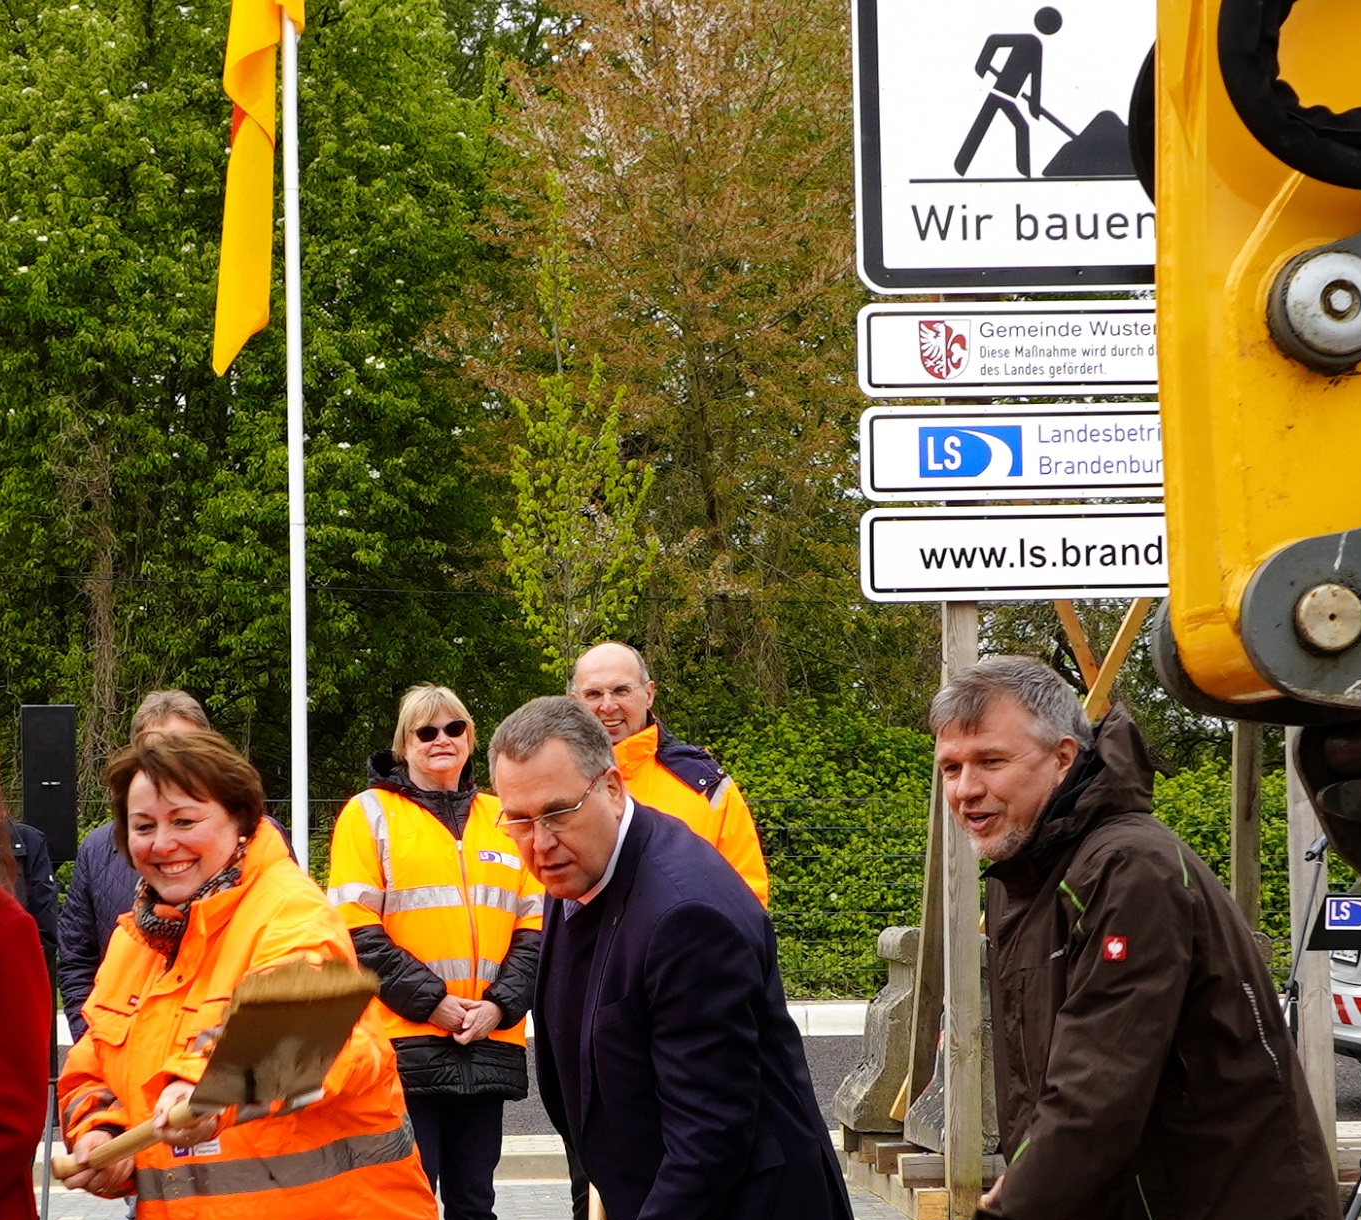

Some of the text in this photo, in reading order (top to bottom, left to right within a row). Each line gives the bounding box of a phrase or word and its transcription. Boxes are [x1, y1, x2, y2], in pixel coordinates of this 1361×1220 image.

[911, 203, 1156, 241] Wir bauen
[980, 321, 1082, 338] Gemeinde
[979, 345, 1010, 358] Diese
[1015, 345, 1077, 358] Maßnahme
[1081, 344, 1106, 357] wird
[1111, 344, 1143, 357] durch
[980, 363, 1000, 375] des
[1004, 362, 1045, 375] Landes
[1038, 423, 1161, 443] Landesbetri
[927, 435, 962, 471] LS
[1039, 454, 1163, 475] Brandenbur
[920, 535, 1163, 569] www.ls.brand
[1331, 901, 1351, 920] LS
